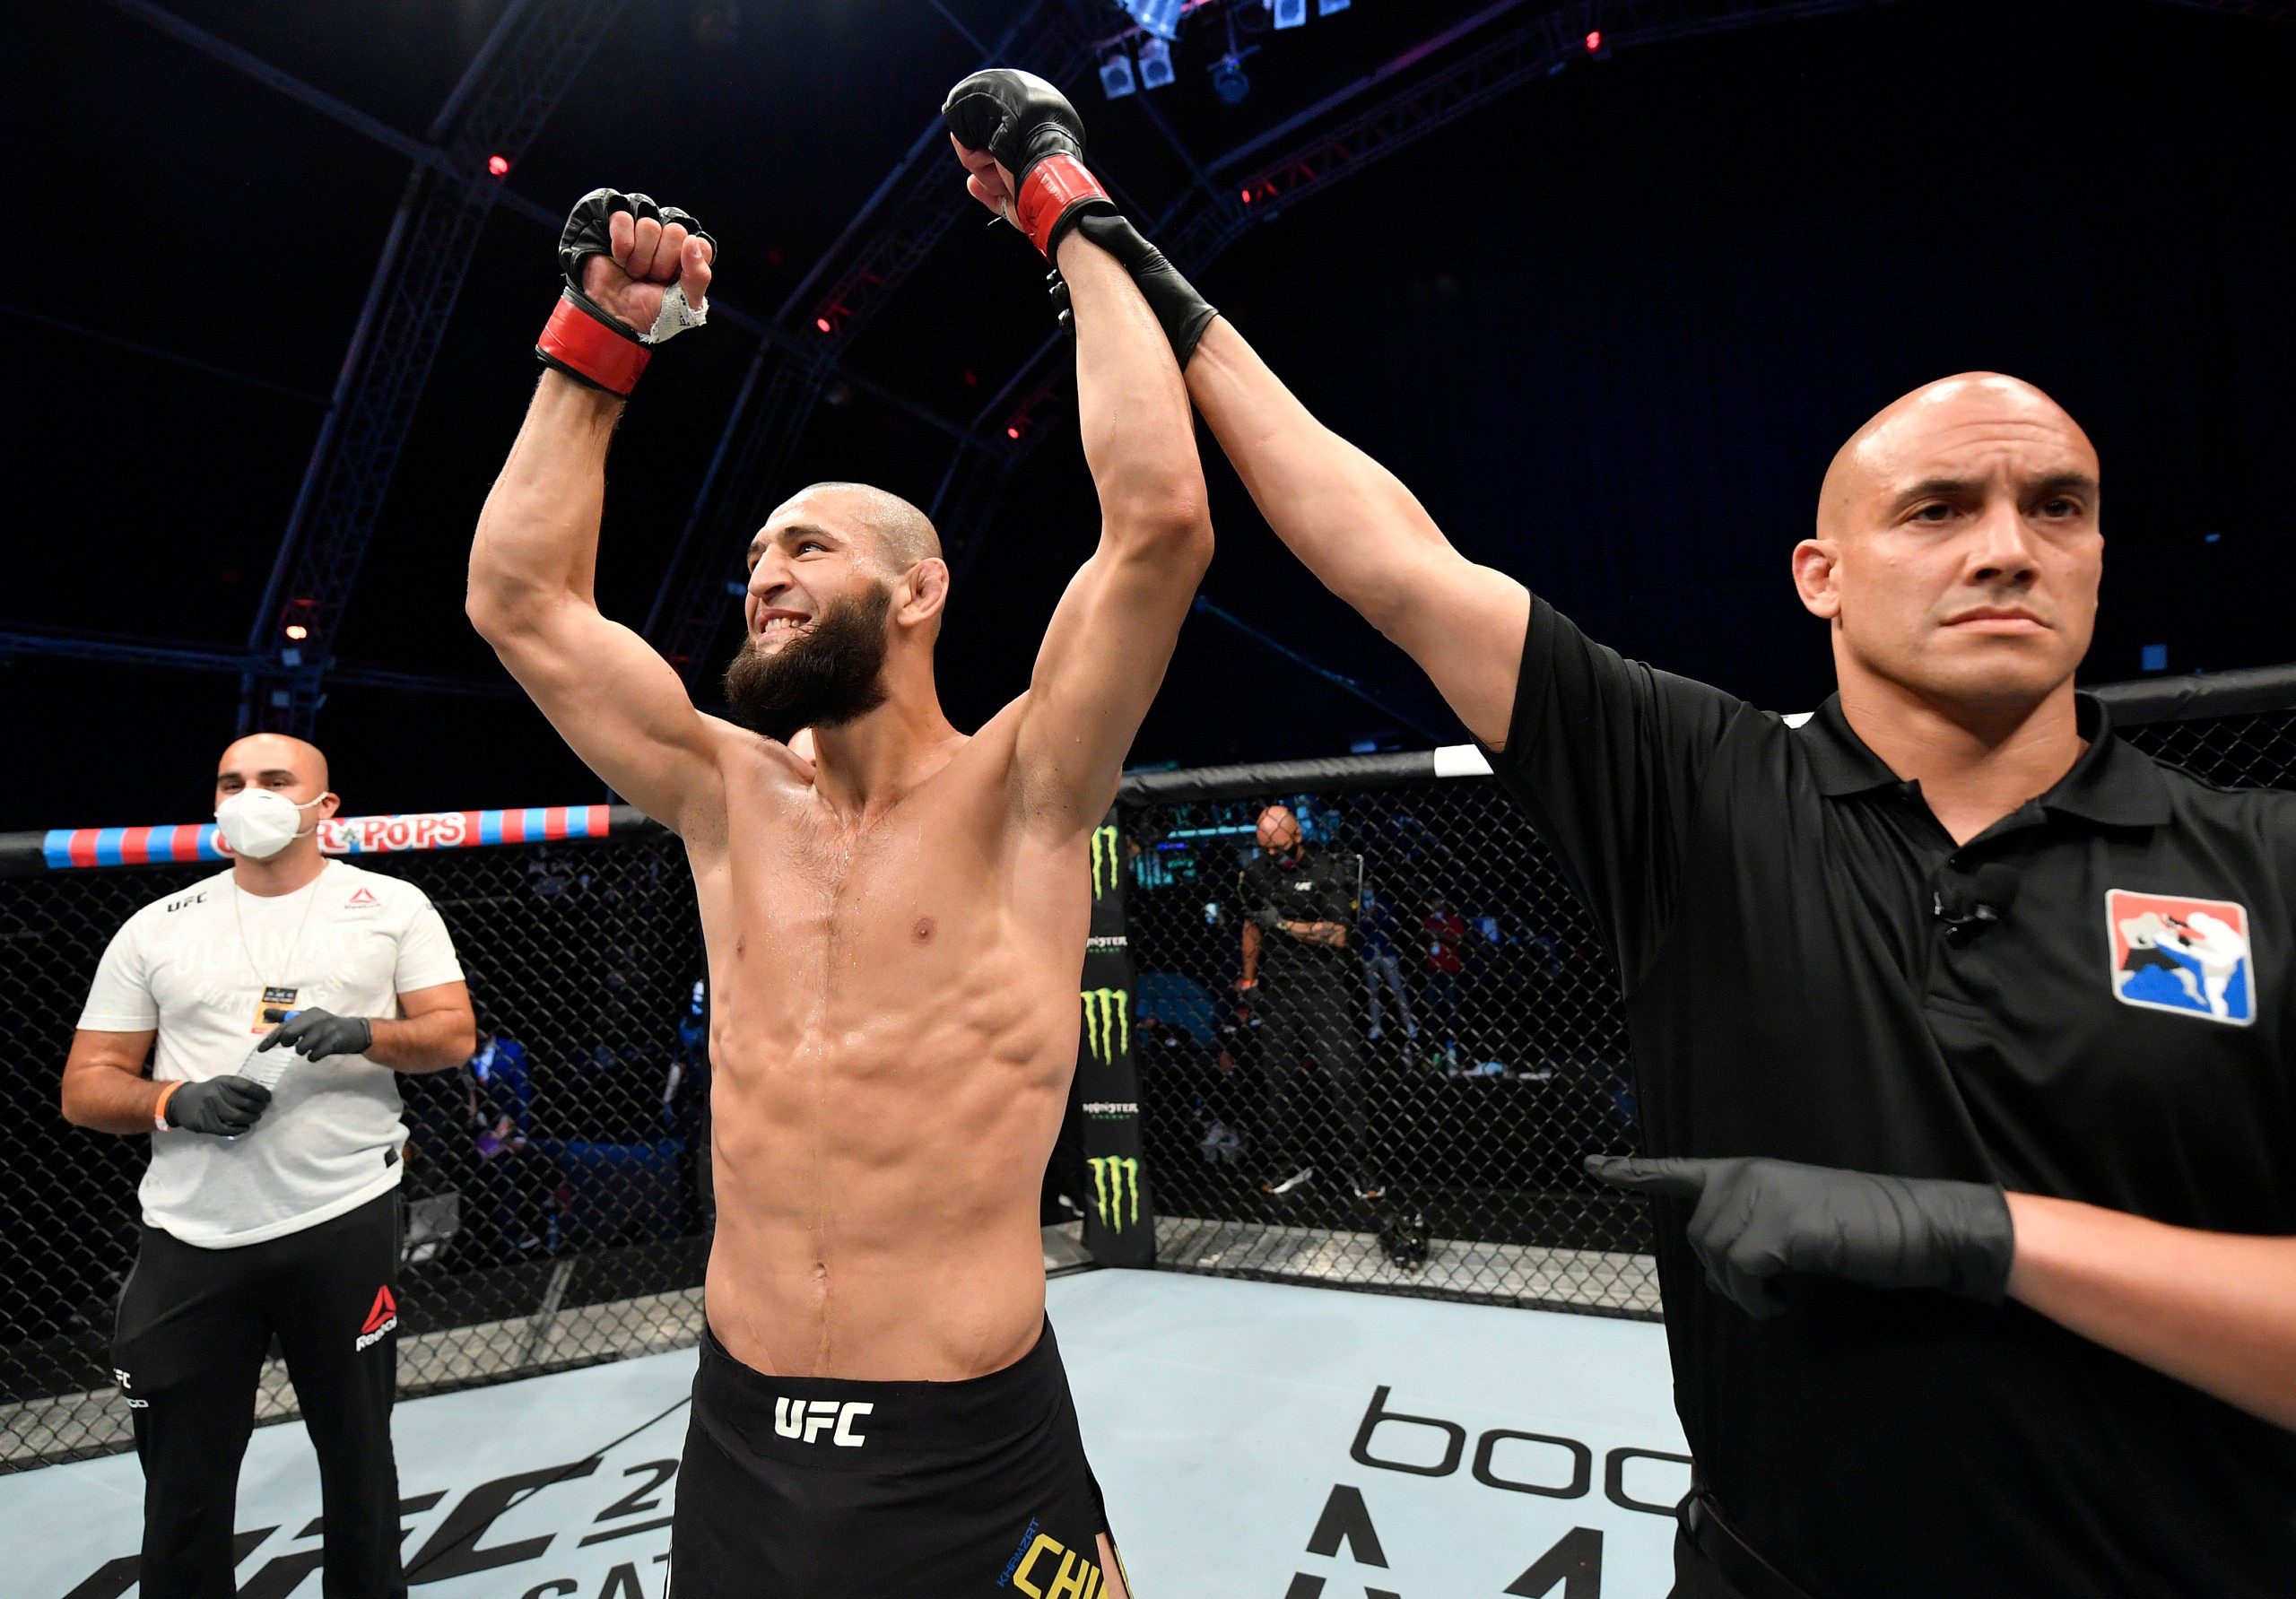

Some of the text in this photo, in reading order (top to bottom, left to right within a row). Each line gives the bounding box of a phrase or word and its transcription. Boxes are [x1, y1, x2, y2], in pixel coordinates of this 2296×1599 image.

[360, 812, 464, 851] POPS
[167, 891, 208, 913] UFC
[774, 1396, 874, 1447] UFC
[996, 1516, 1039, 1587] KHAMZAT
